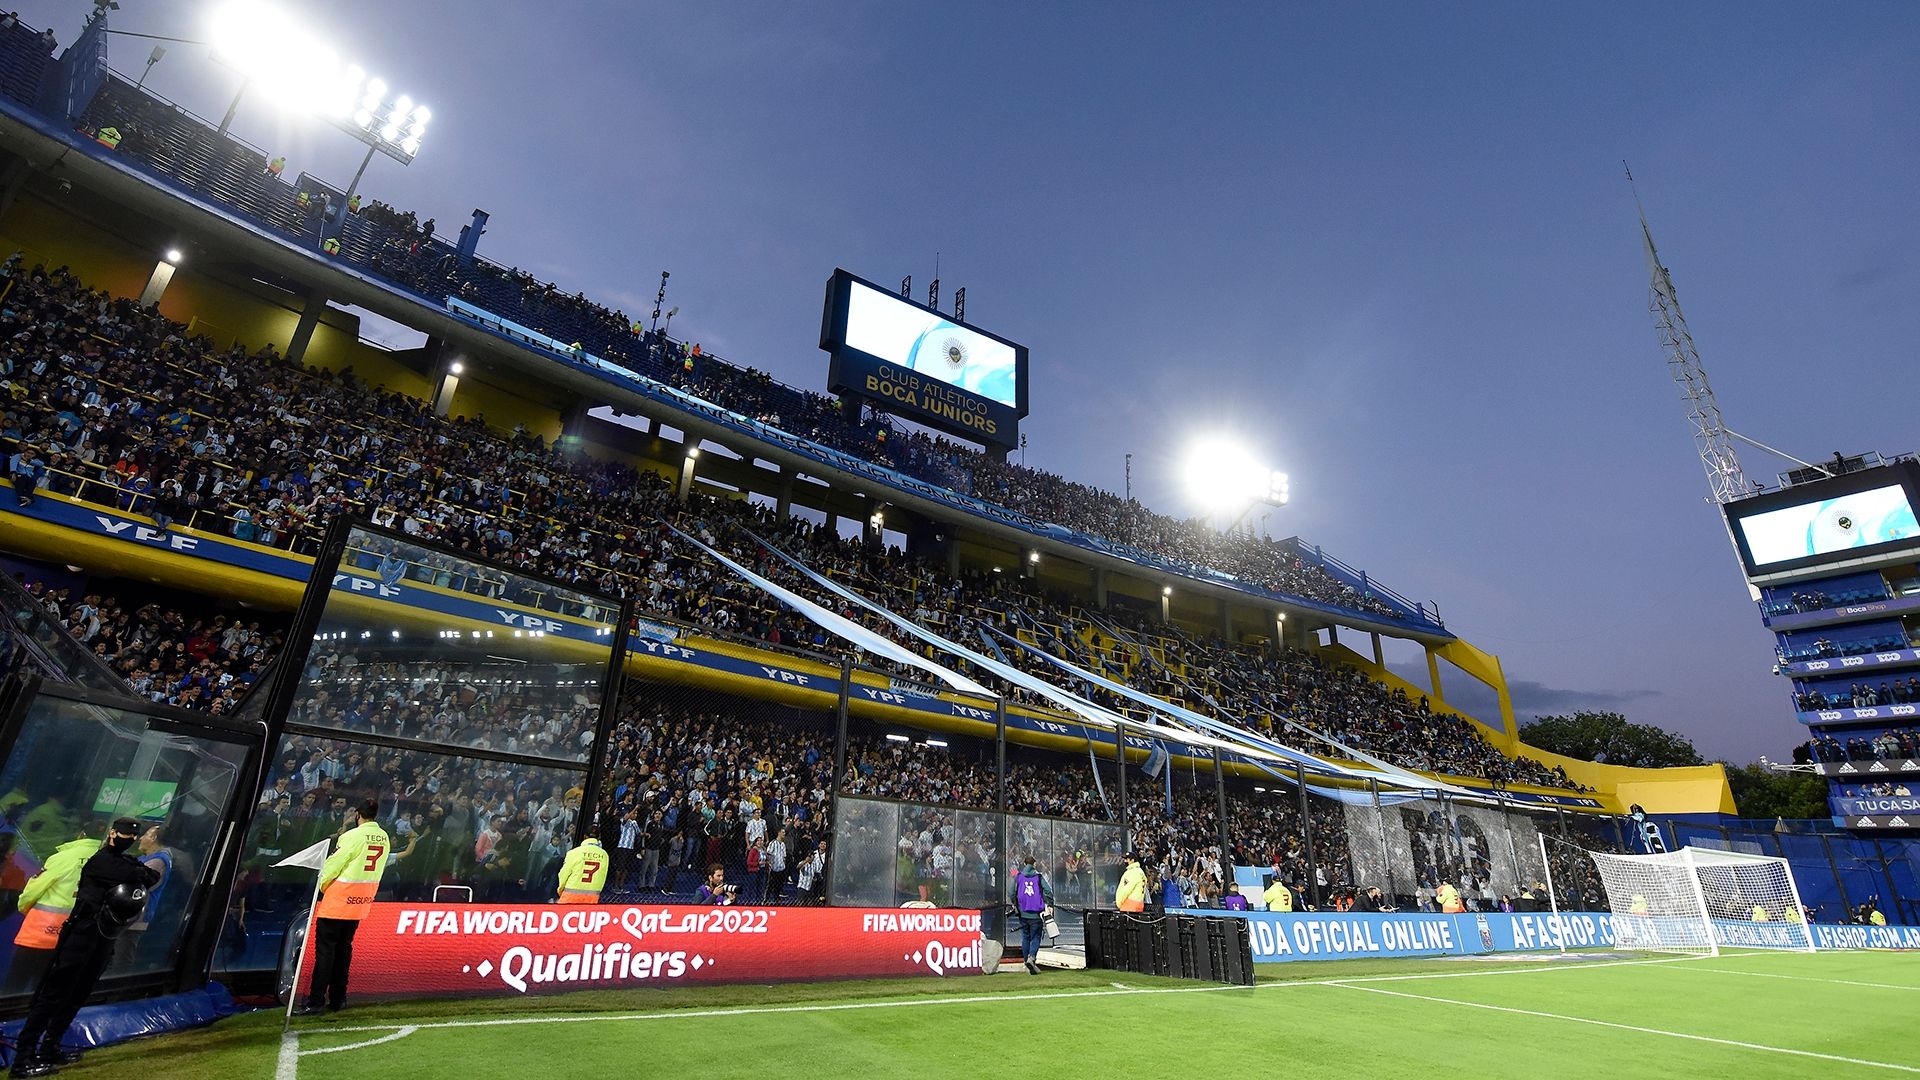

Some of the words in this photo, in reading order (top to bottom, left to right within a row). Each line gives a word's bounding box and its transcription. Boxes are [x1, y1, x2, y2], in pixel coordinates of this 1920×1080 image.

[878, 365, 920, 389] CLUB
[923, 382, 988, 416] ATLÉTICO
[866, 375, 918, 406] BOCA
[922, 397, 997, 434] JUNIORS
[95, 515, 199, 550] YPF
[332, 574, 401, 597] YPF
[1847, 604, 1867, 614] Boca
[1867, 603, 1887, 613] Shop
[496, 610, 564, 633] YPF
[640, 637, 696, 660] YPF
[760, 666, 809, 686] YPF
[863, 687, 906, 704] YPF
[954, 704, 992, 720] YPF
[1034, 720, 1068, 733] YPF
[1124, 736, 1153, 748] YPF
[1537, 795, 1559, 803] YPF
[1576, 798, 1596, 807] YPF
[1856, 800, 1878, 811] TU
[1880, 800, 1920, 811] CASA
[366, 834, 387, 842] TECH
[364, 845, 384, 871] 3
[583, 852, 604, 860] TECH
[581, 861, 601, 883] 3
[397, 911, 460, 935] FIFA
[463, 911, 559, 935] WORLD
[561, 911, 607, 934] CUP
[863, 914, 898, 932] FIFA
[899, 914, 955, 932] WORLD
[1293, 916, 1380, 955] OFICIAL
[1383, 916, 1454, 952] ONLINE
[1817, 927, 1920, 949] AFASHOP.COM.AR
[500, 942, 686, 993] Qualifiers
[925, 940, 982, 976] Quali
